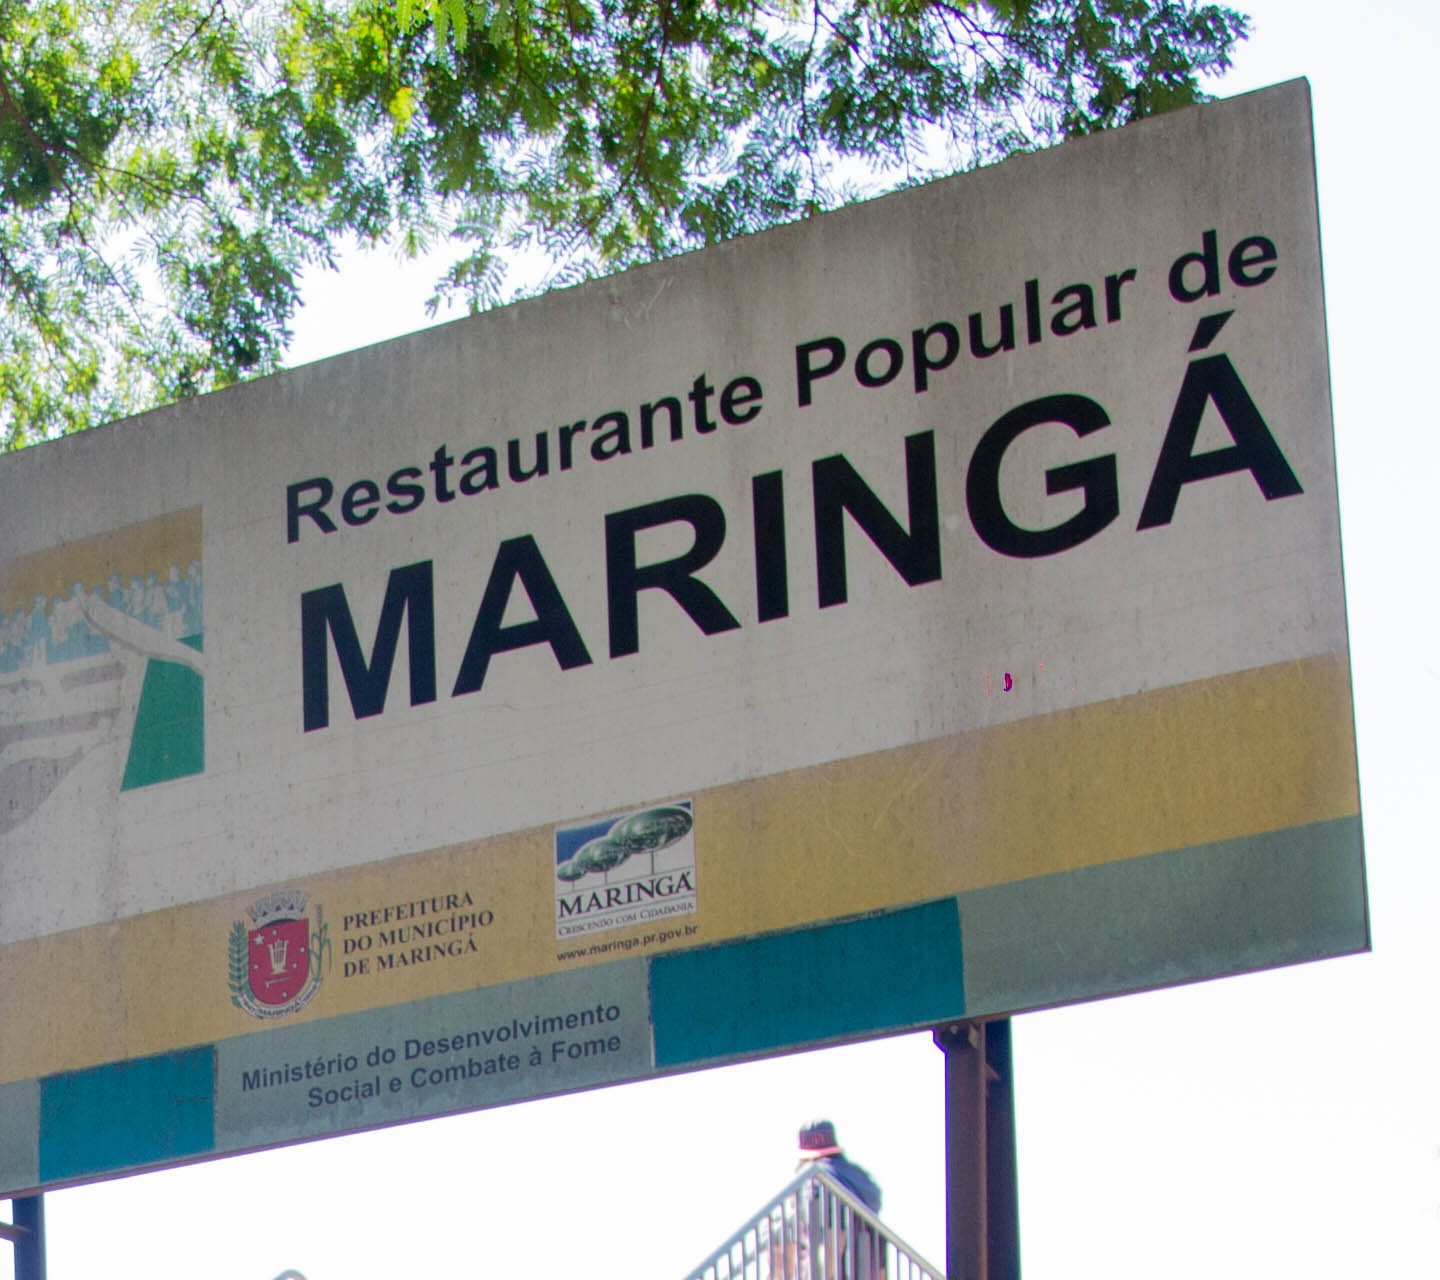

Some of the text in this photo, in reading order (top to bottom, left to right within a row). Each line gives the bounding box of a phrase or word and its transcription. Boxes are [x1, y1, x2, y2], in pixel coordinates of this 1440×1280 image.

[285, 229, 1279, 544] Restaurante Popular de
[300, 310, 1305, 734] MARINGÁ
[342, 891, 475, 931] PREFEITURA
[558, 871, 694, 919] MARINGÁ
[343, 909, 495, 954] DO MUNICÍPIO
[343, 933, 479, 978] DE MARINGÁ
[556, 923, 698, 961] www.maringa.pr.gov.br
[241, 1003, 621, 1093] Ministério do Desenvolvimento
[307, 1035, 621, 1109] Social e Combate à Fome
